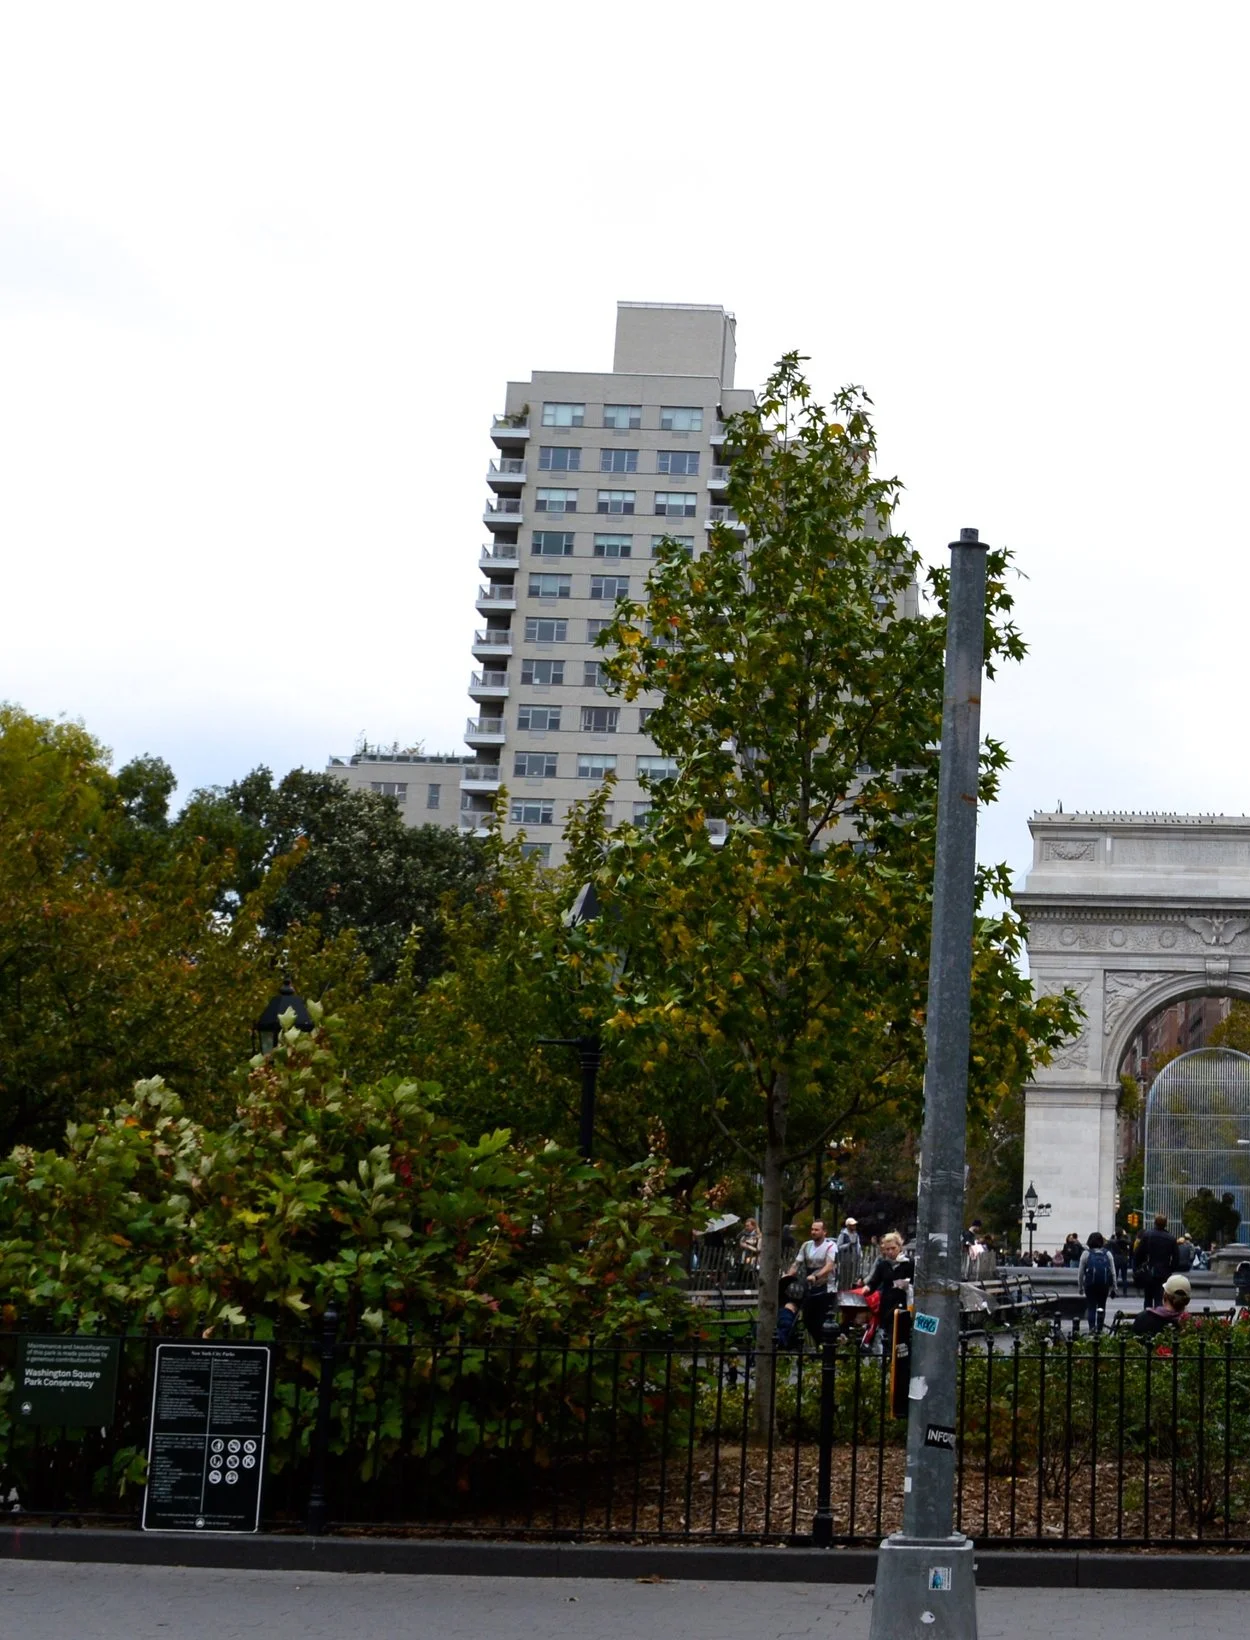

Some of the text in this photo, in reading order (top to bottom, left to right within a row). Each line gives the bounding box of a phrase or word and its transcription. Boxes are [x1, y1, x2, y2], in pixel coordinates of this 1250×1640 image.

[24, 1368, 101, 1379] Washington Square
[24, 1377, 94, 1389] Park Conservancy
